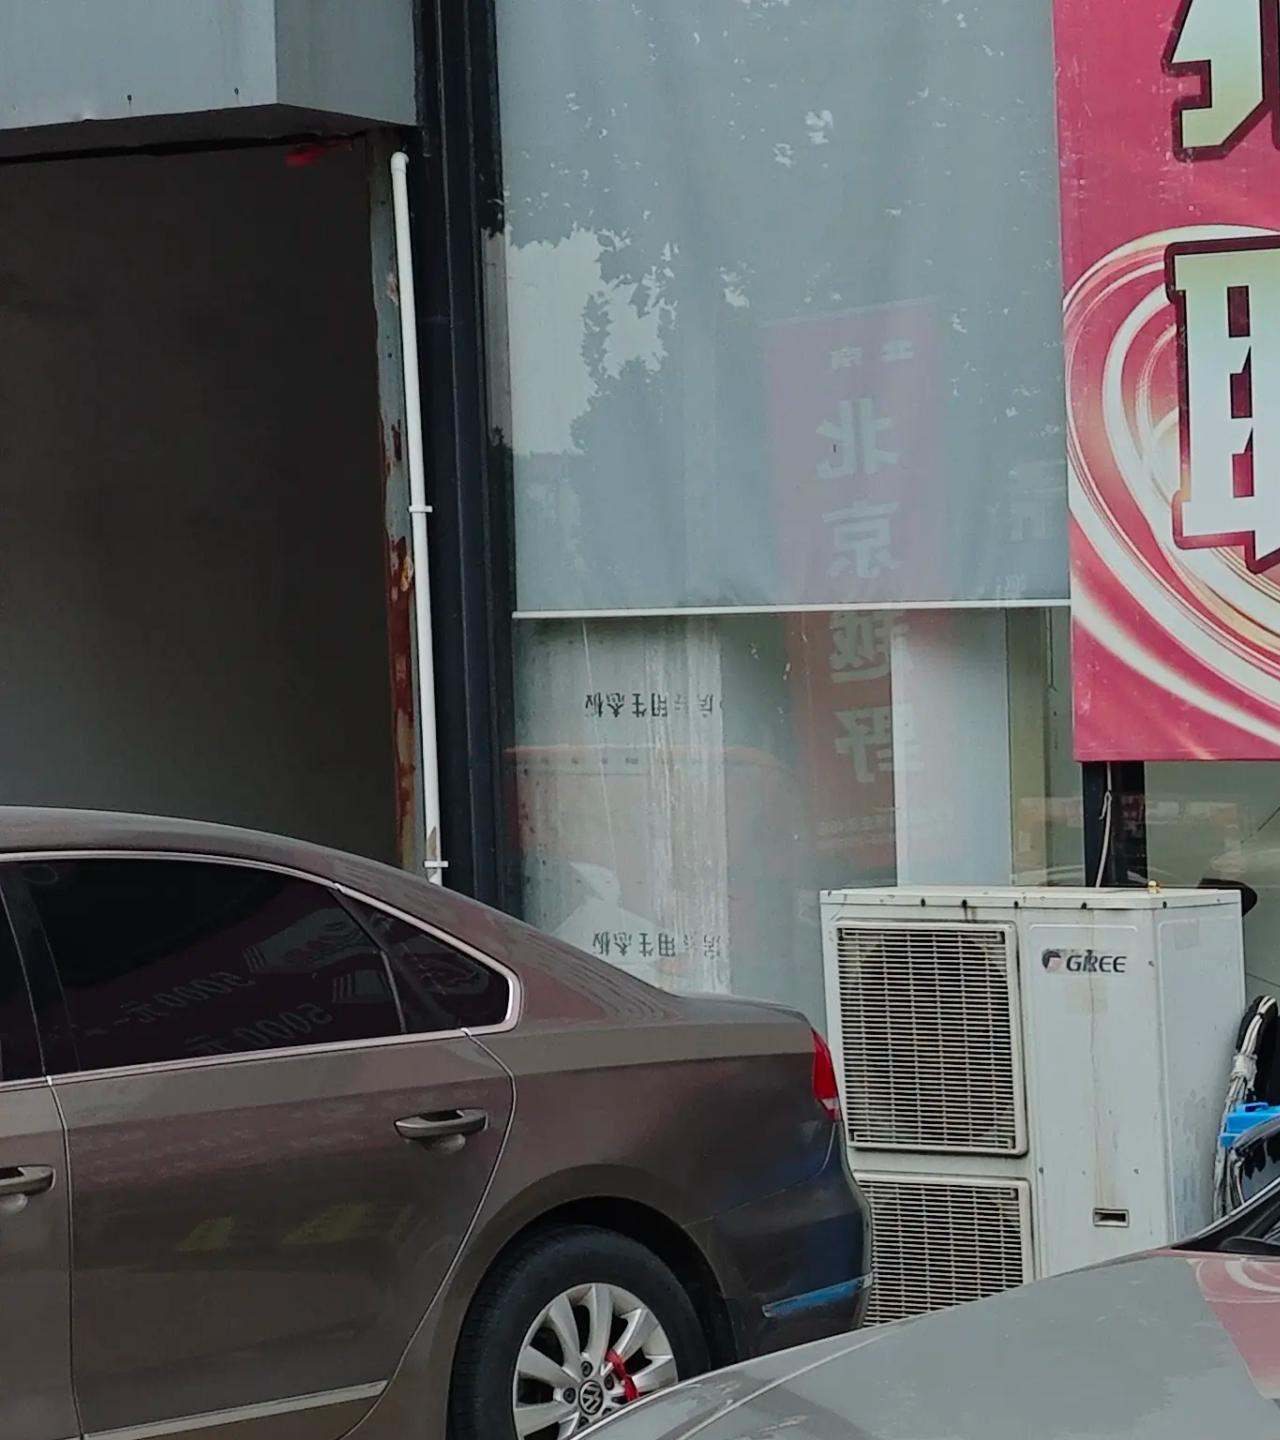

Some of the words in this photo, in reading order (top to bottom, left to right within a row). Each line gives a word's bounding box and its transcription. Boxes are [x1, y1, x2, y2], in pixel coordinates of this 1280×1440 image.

[584, 690, 715, 719] 房用生态板
[592, 931, 721, 961] 房用生态板
[1066, 953, 1127, 974] GREE
